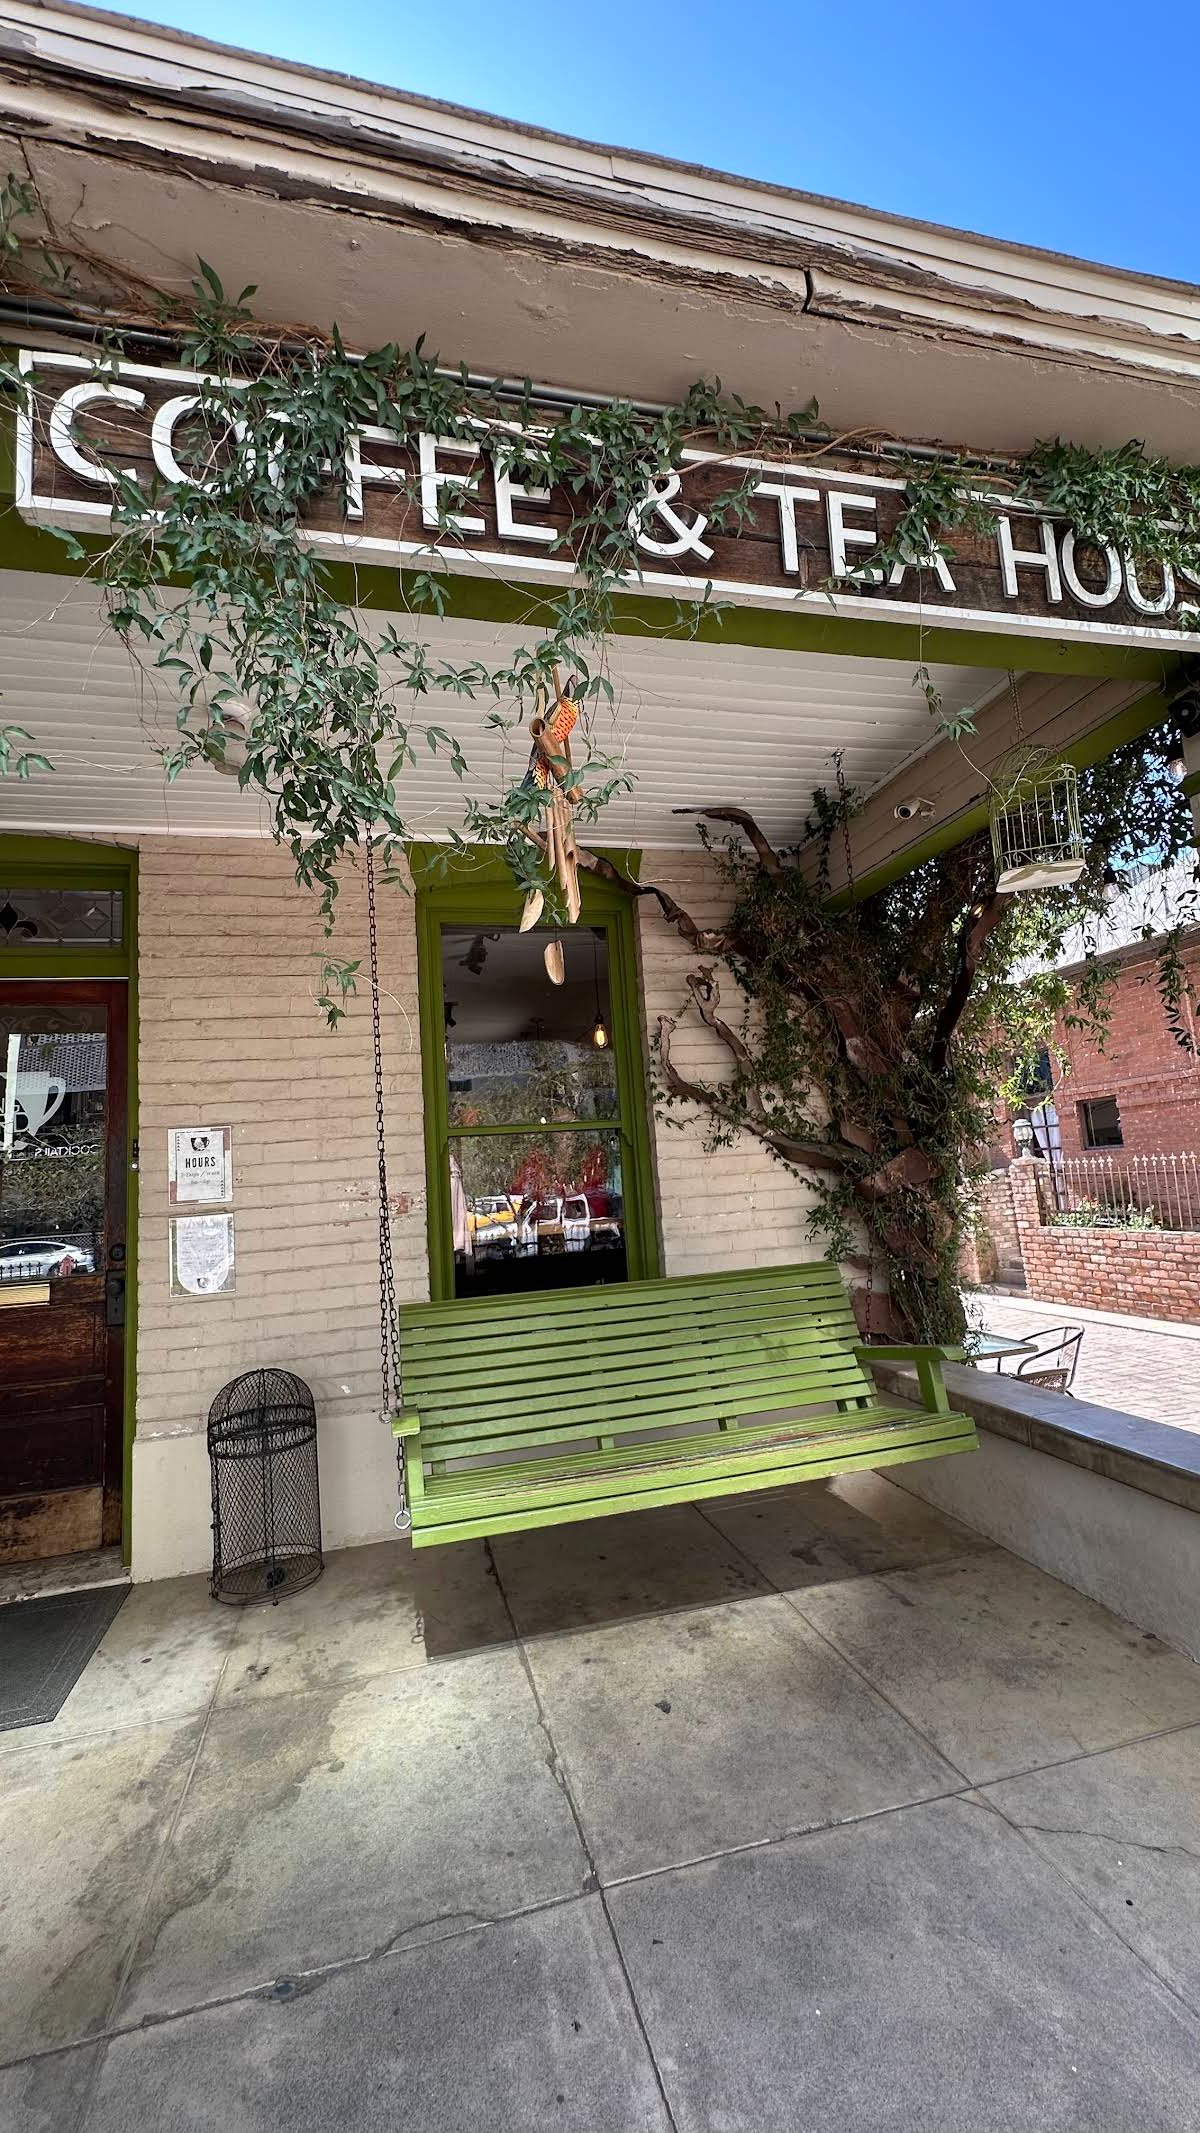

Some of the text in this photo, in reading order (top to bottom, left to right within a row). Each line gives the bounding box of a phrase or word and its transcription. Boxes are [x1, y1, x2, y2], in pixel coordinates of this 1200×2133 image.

[628, 465, 715, 563] &
[753, 481, 957, 593] TEA
[185, 1156, 216, 1169] HOURS
